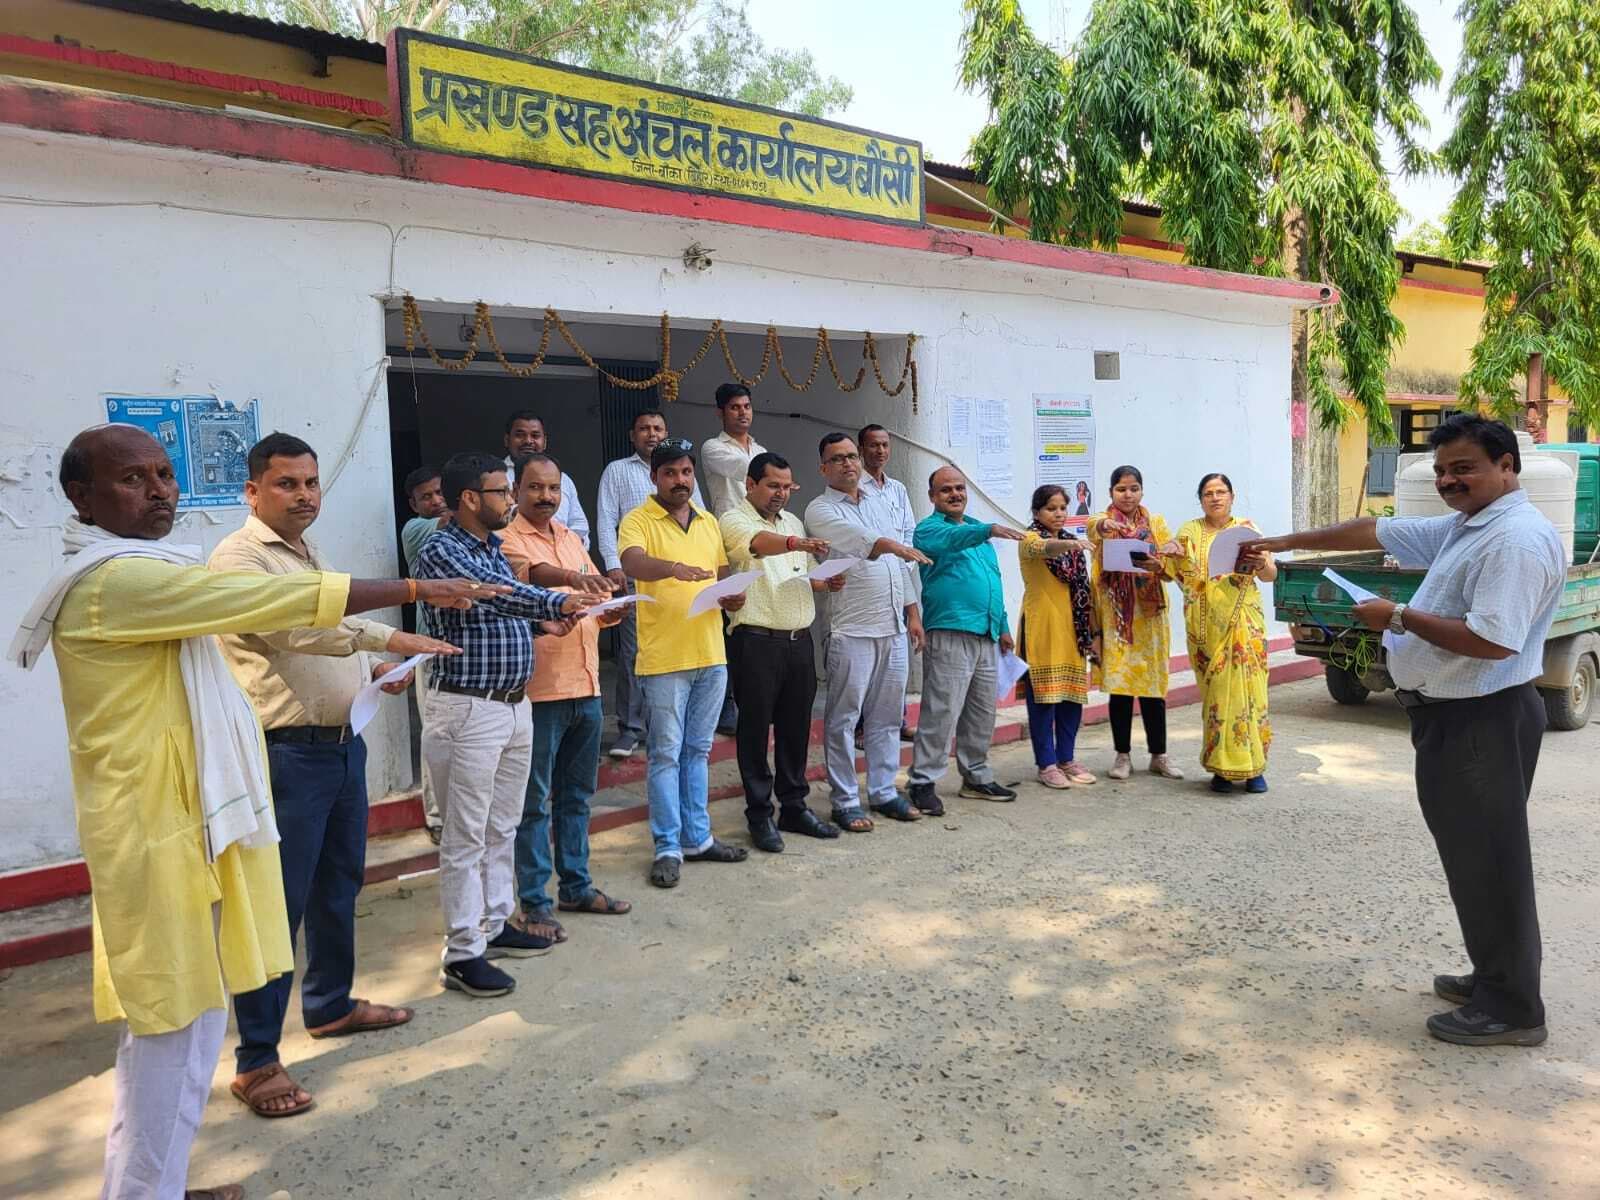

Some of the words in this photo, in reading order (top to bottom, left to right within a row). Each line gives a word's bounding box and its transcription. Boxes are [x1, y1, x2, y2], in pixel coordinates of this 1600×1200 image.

[414, 67, 553, 138] प्रखण्ड
[555, 95, 613, 159] सह
[613, 97, 712, 169] अंचल
[717, 121, 854, 195] कार्यालय
[855, 138, 915, 207] बौंसी
